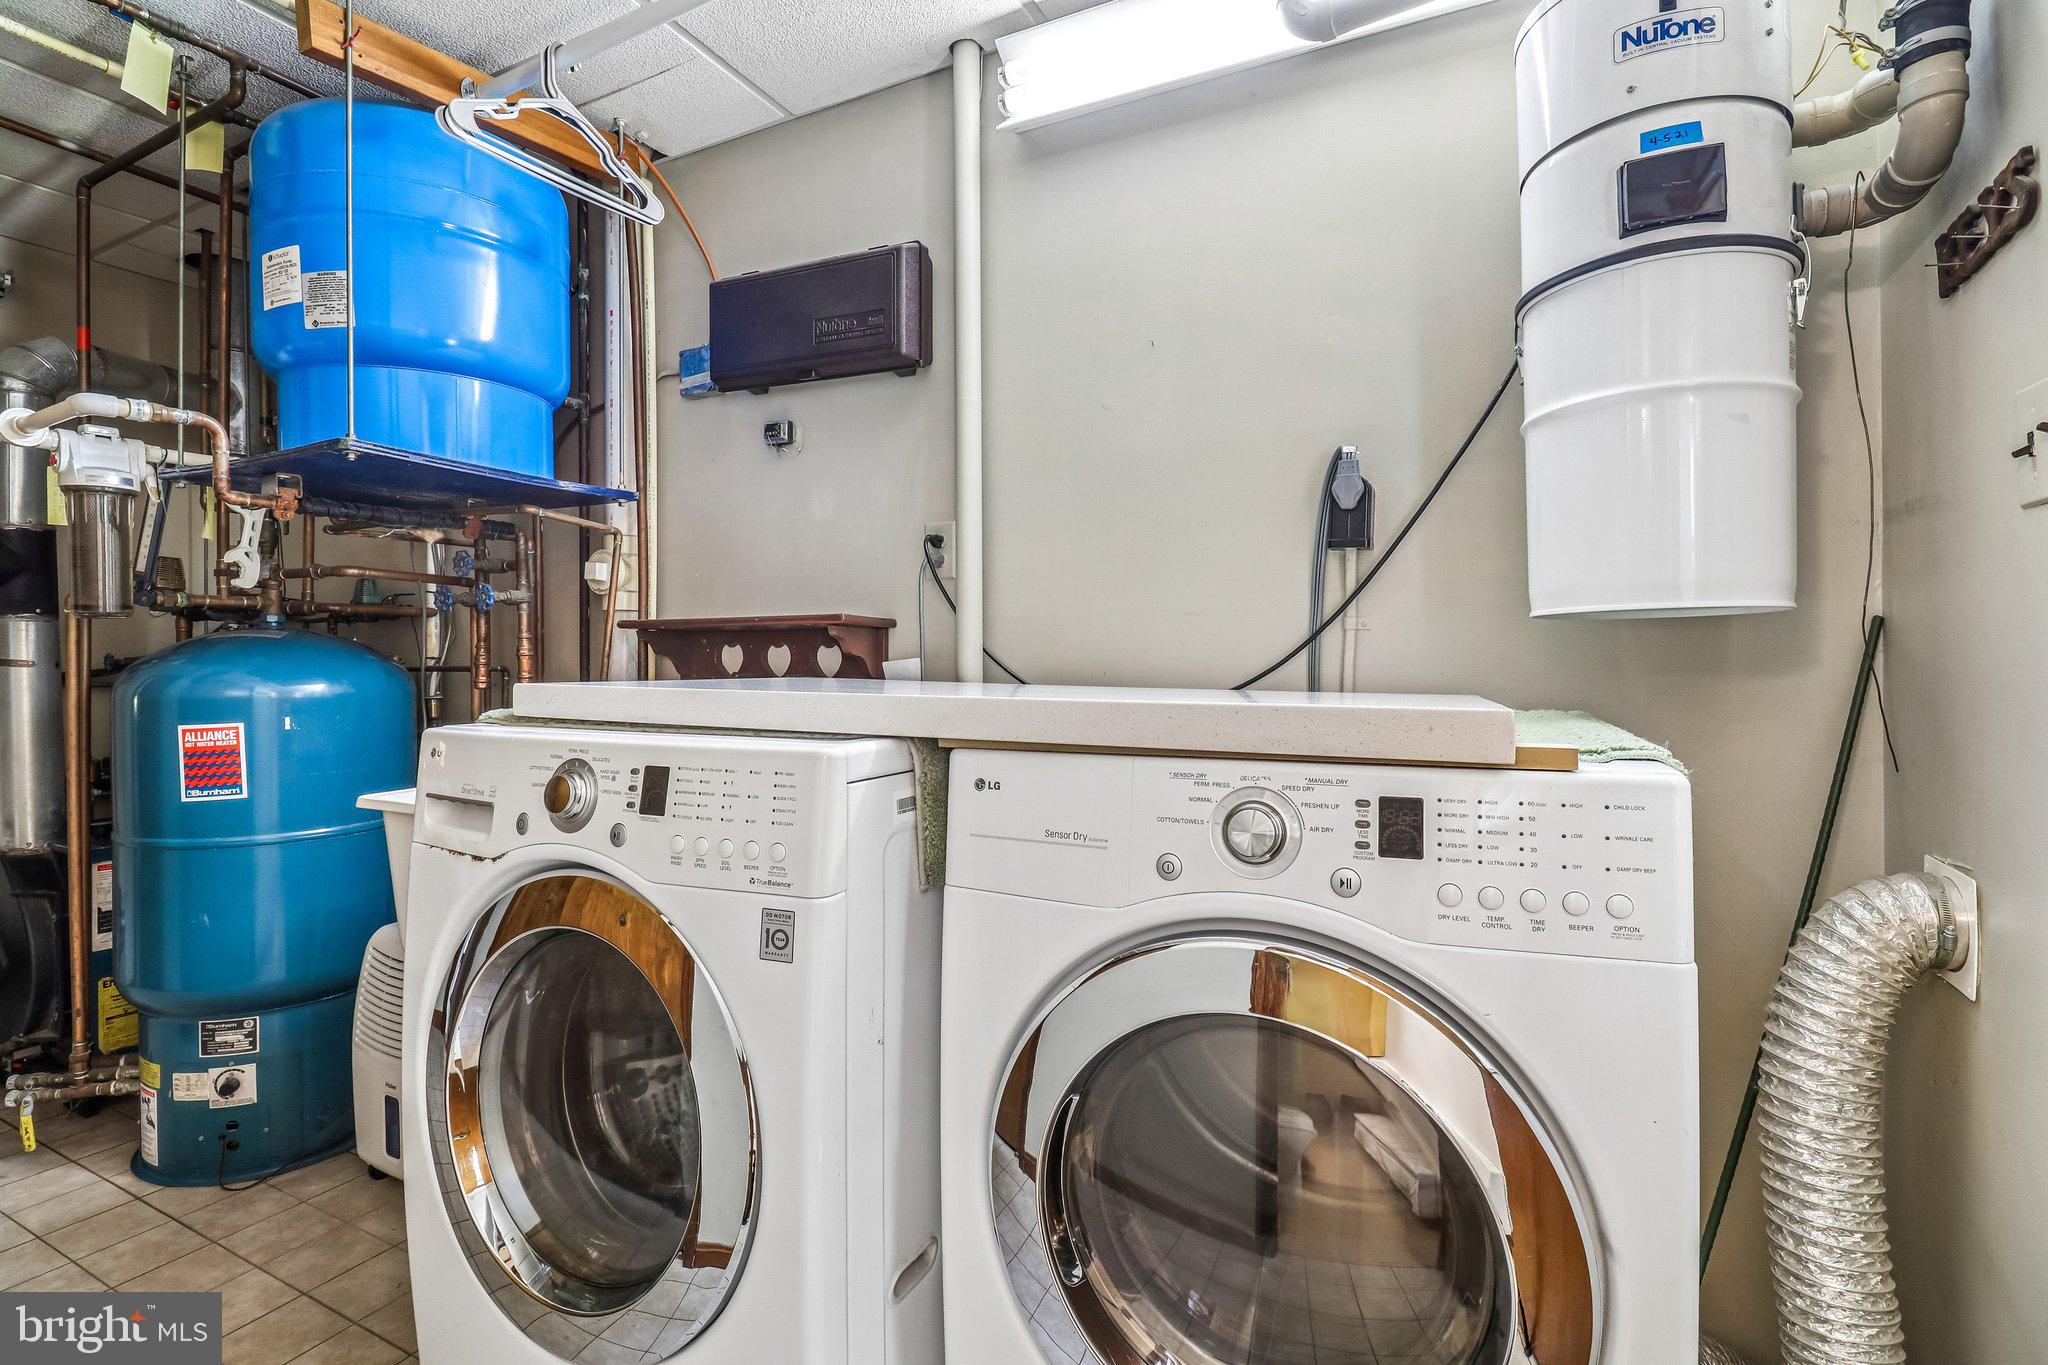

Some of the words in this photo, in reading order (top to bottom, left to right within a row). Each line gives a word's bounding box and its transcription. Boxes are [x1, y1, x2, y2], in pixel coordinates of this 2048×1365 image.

[1621, 17, 1716, 52] NuTone
[1645, 40, 1669, 50] CENTRAL
[1670, 36, 1694, 45] VACUUM
[1693, 33, 1717, 41] SYSTEMS
[185, 729, 237, 743] ALLIANCE
[216, 739, 238, 747] HEATER
[988, 781, 1001, 790] LG
[1281, 784, 1301, 792] SPEED
[192, 786, 241, 798] Burnham
[1188, 796, 1213, 804] NORMAL
[1300, 802, 1329, 810] FRESHEN
[1156, 816, 1205, 825] COTTON/TOWELS
[1044, 829, 1072, 840] Sensor
[1073, 831, 1088, 844] Dry
[1437, 913, 1451, 921] DRY
[1451, 915, 1471, 923] LEVEL
[1529, 918, 1546, 926] TIME
[1481, 921, 1513, 931] CONTROL
[1568, 923, 1595, 932] BEEPER
[1613, 925, 1640, 933] OPTION
[765, 927, 790, 951] 10
